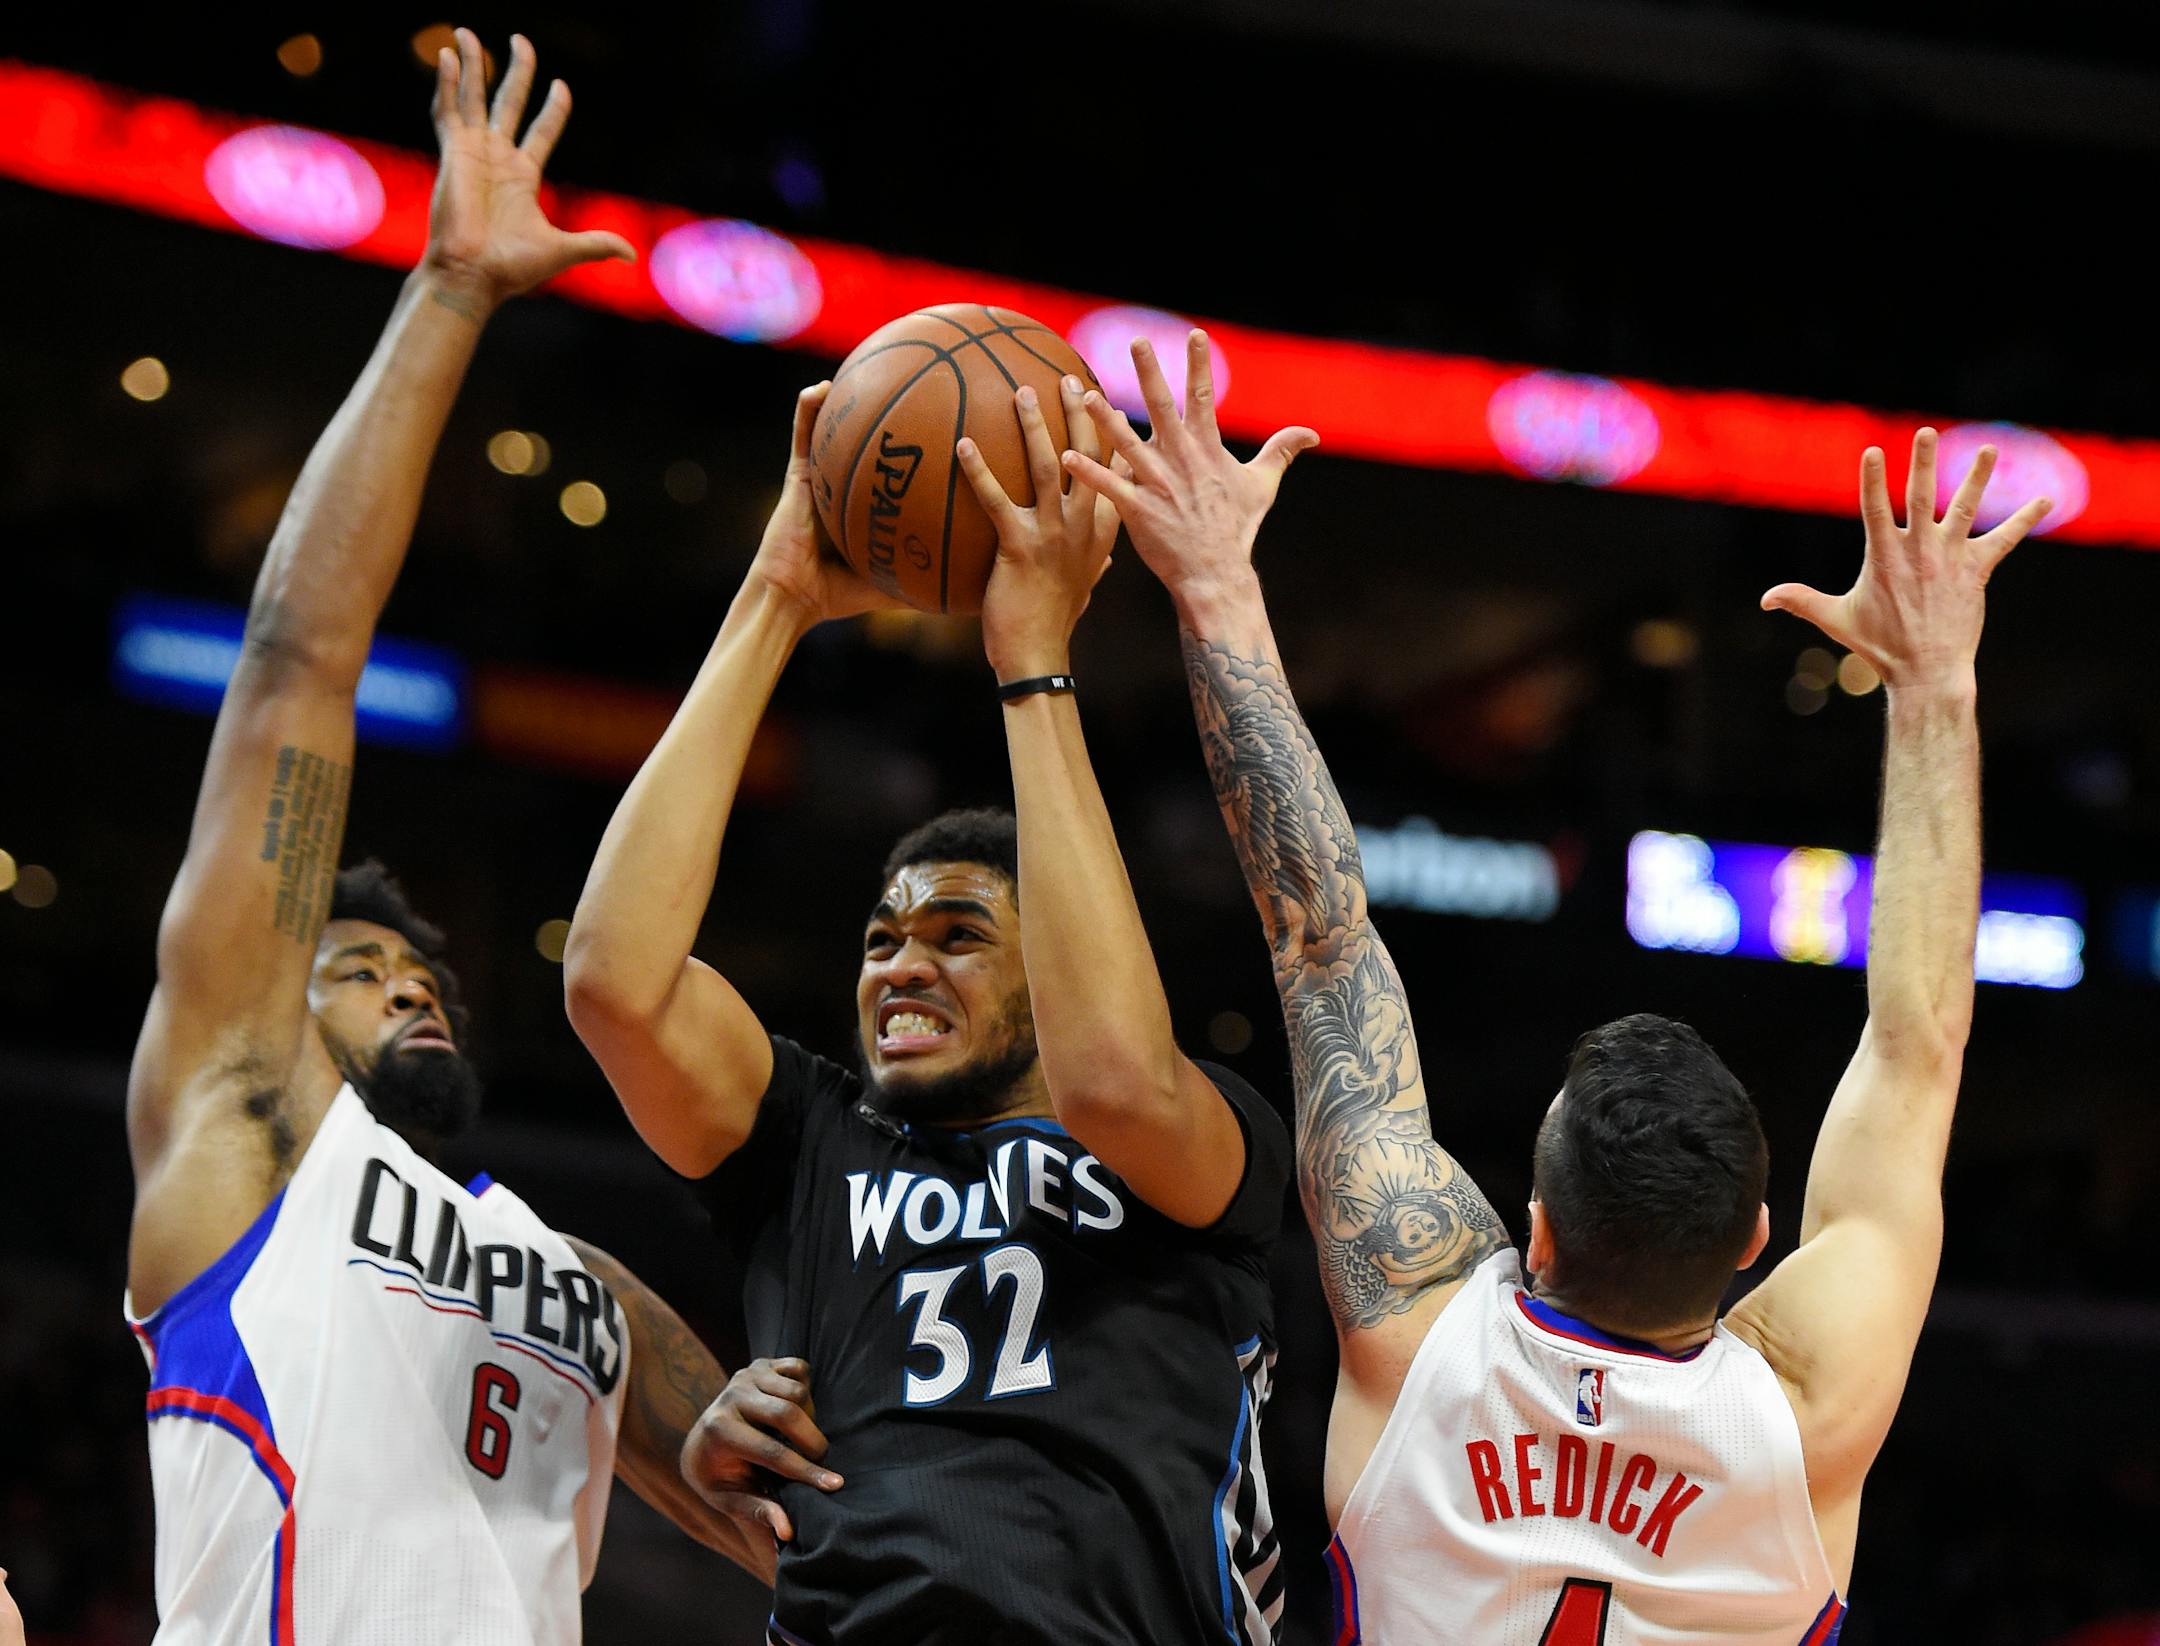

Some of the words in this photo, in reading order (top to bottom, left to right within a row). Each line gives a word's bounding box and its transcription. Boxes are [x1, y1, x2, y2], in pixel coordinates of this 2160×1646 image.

[846, 1138, 1125, 1266] WOLVES
[898, 1243, 1056, 1406] 32
[465, 1361, 522, 1481] 6
[1466, 1433, 1704, 1558] REDICK
